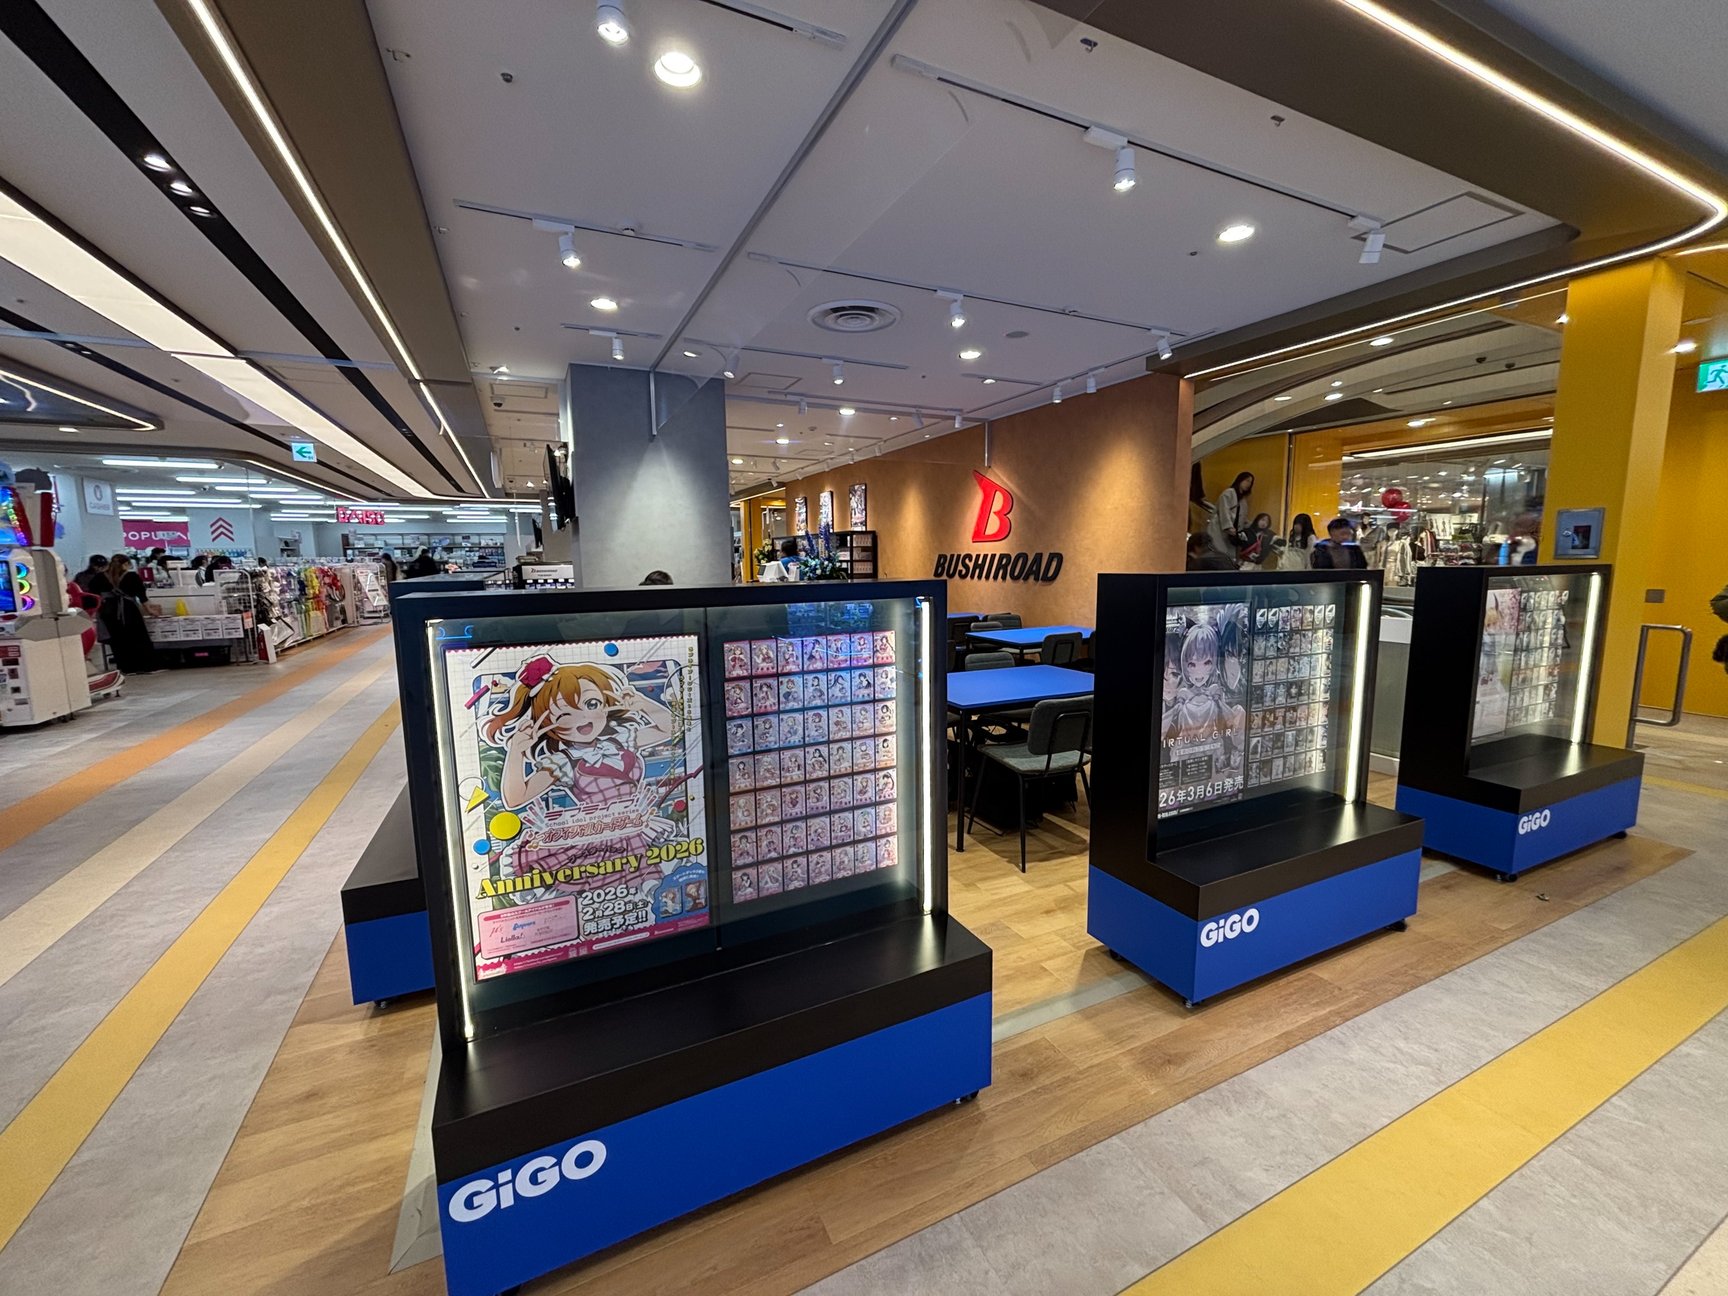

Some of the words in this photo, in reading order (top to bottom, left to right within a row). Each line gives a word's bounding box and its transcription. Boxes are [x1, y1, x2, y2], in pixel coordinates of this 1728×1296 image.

[933, 552, 1063, 582] BUSHIROAD
[1518, 809, 1550, 835] GiGO
[475, 852, 642, 899] Anniversary
[646, 838, 704, 865] 2026
[581, 884, 637, 905] 2026年
[1200, 908, 1260, 948] GiGO
[448, 1139, 607, 1223] GiGO
